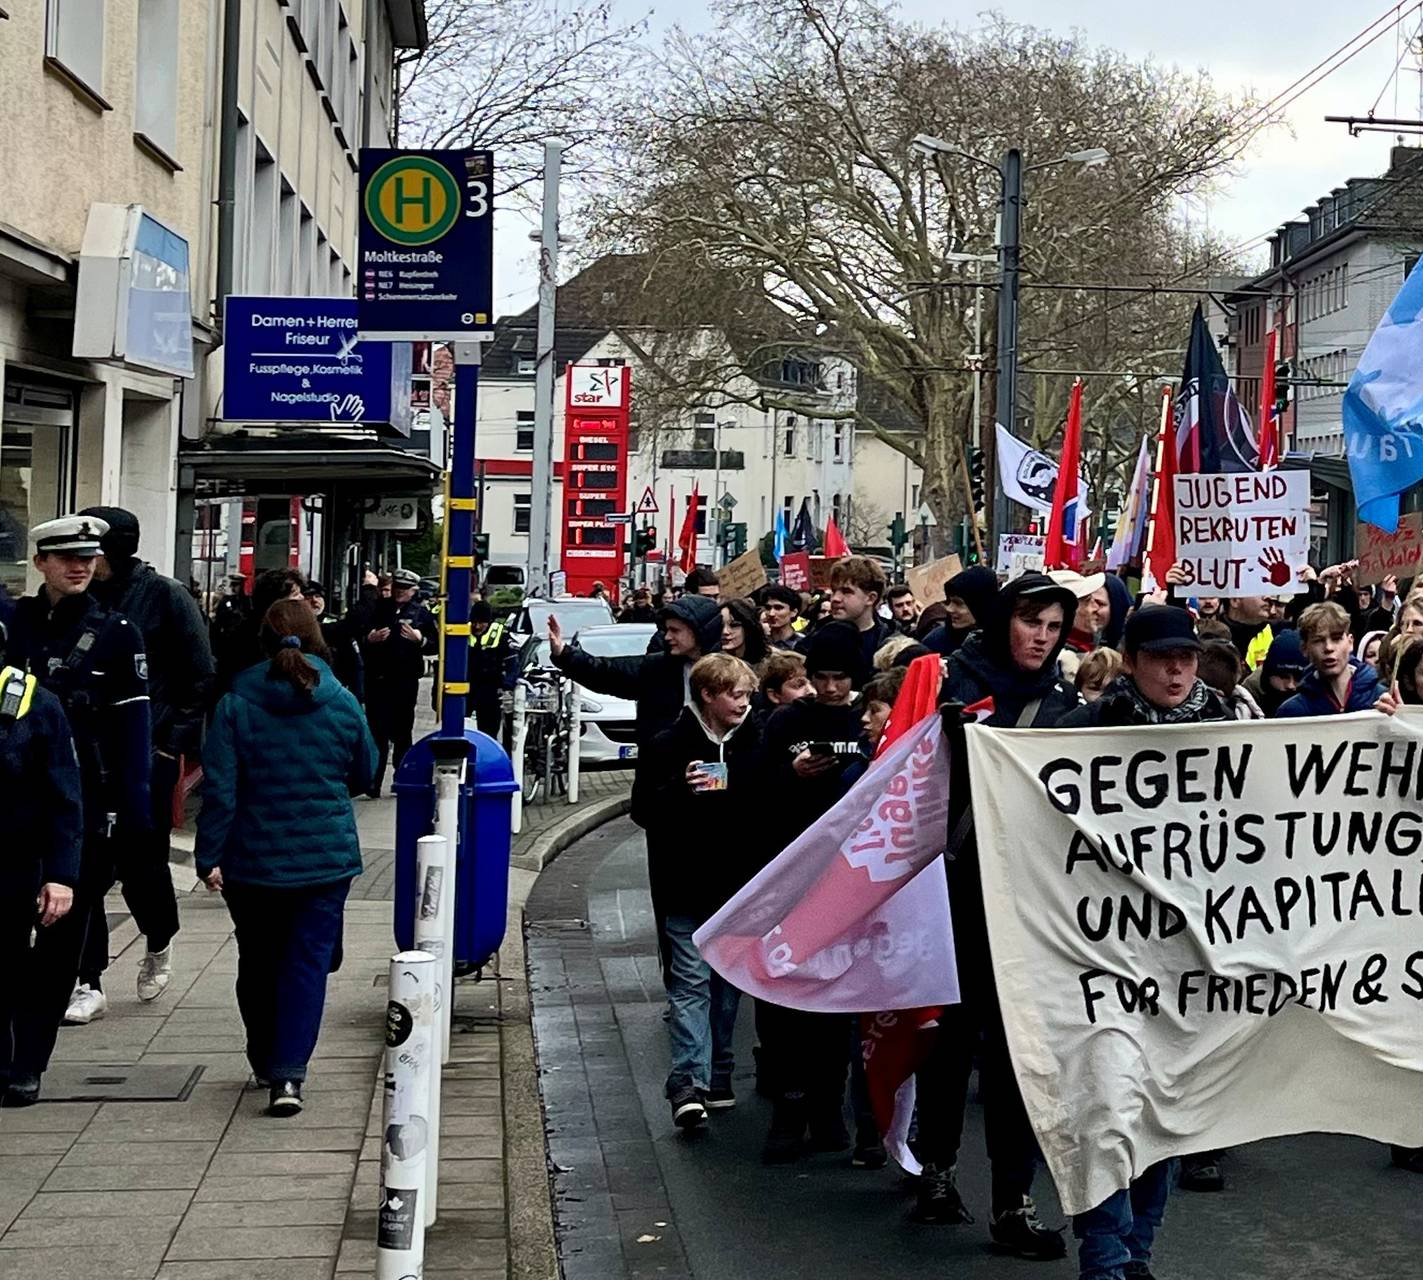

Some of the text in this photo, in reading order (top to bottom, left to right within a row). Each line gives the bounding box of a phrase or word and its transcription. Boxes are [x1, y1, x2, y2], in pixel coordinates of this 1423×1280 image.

[395, 177, 431, 224] H
[465, 180, 488, 217] 3
[364, 250, 443, 263] Moltkestraße
[285, 332, 331, 345] Friseur
[271, 392, 341, 404] Nagelstudio
[301, 378, 311, 388] &
[574, 393, 603, 403] star
[1178, 475, 1288, 509] JUGEND
[1180, 515, 1297, 546] REKRUTEN
[1038, 744, 1253, 815] GEGEN
[1077, 892, 1188, 941] UND
[1178, 960, 1347, 1017] FRIEDEN
[1352, 952, 1389, 1002] &
